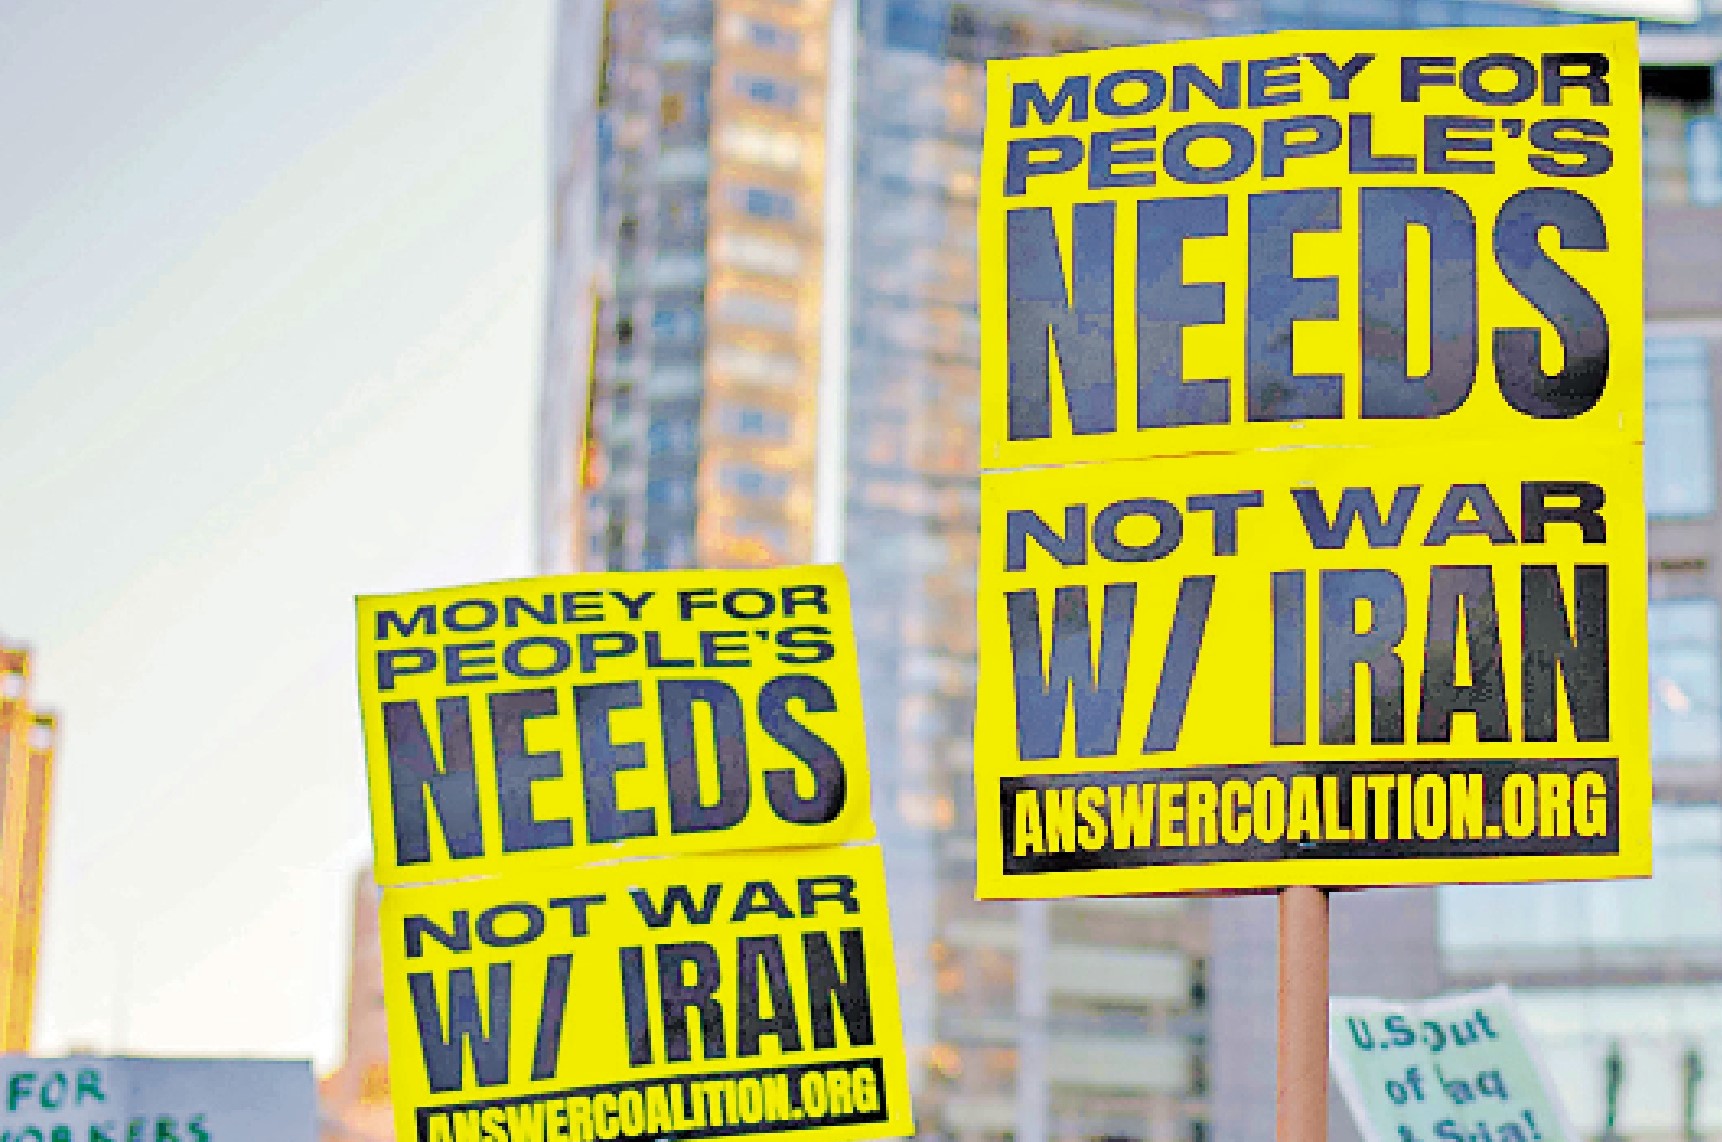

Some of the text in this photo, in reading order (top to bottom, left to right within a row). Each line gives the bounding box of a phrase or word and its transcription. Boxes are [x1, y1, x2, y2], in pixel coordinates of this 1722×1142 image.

[1010, 52, 1612, 128] MONEY FOR
[1004, 112, 1614, 196] PEOPLE'S
[1006, 187, 1610, 441] NEEDS
[1004, 480, 1607, 572] NOT WAR
[374, 584, 829, 640] MONEY FOR
[378, 627, 835, 692] PEOPLE'S
[1004, 563, 1610, 761] W/ IRAN
[380, 674, 848, 867] NEEDS
[1014, 770, 1608, 858] ANSWERCOALITION.ORG
[403, 875, 861, 959] NOT WAR
[407, 928, 875, 1094] W/ IRAN
[7, 1066, 106, 1112] FOR
[1385, 1066, 1425, 1105] of
